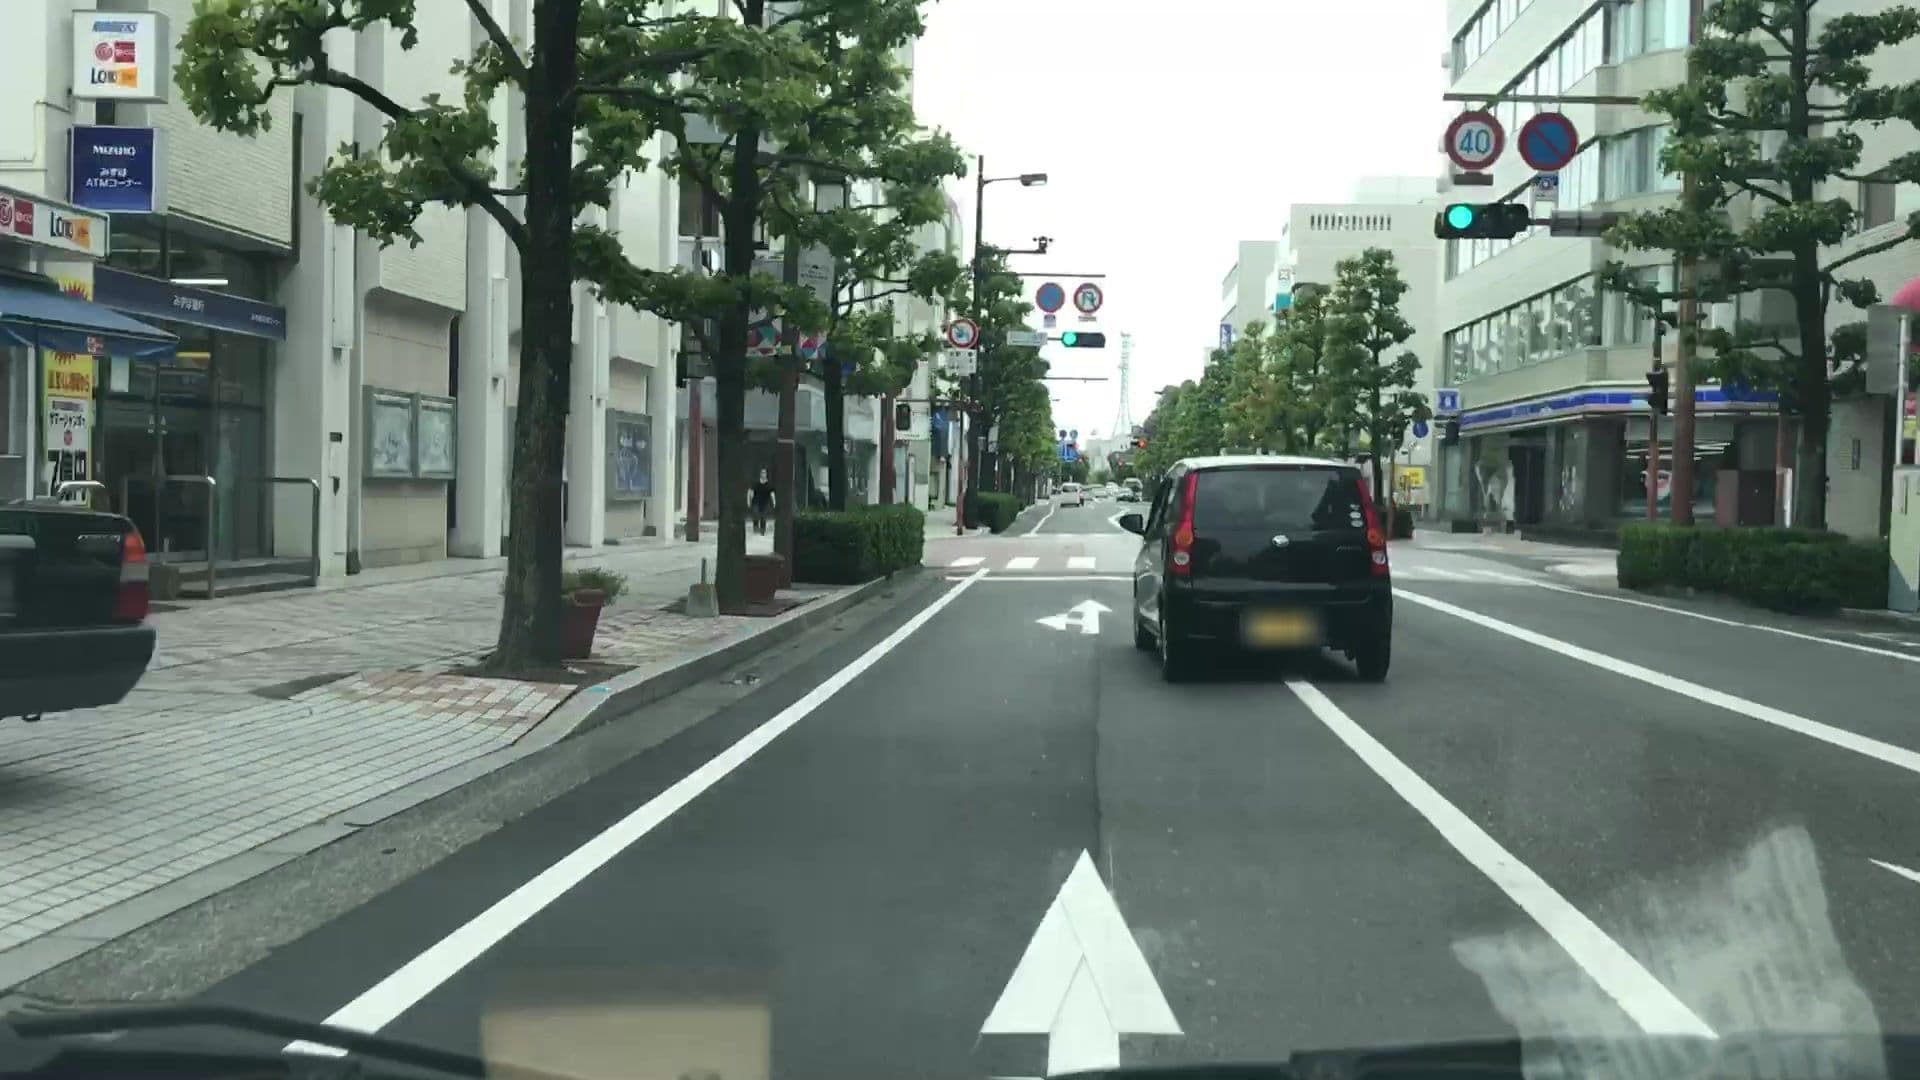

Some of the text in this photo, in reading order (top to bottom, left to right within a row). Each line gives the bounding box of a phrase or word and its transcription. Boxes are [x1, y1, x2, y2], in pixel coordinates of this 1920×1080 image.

[1459, 129, 1491, 154] 40
[93, 145, 136, 156] MIZUHO
[85, 177, 142, 188] ATMコーナー
